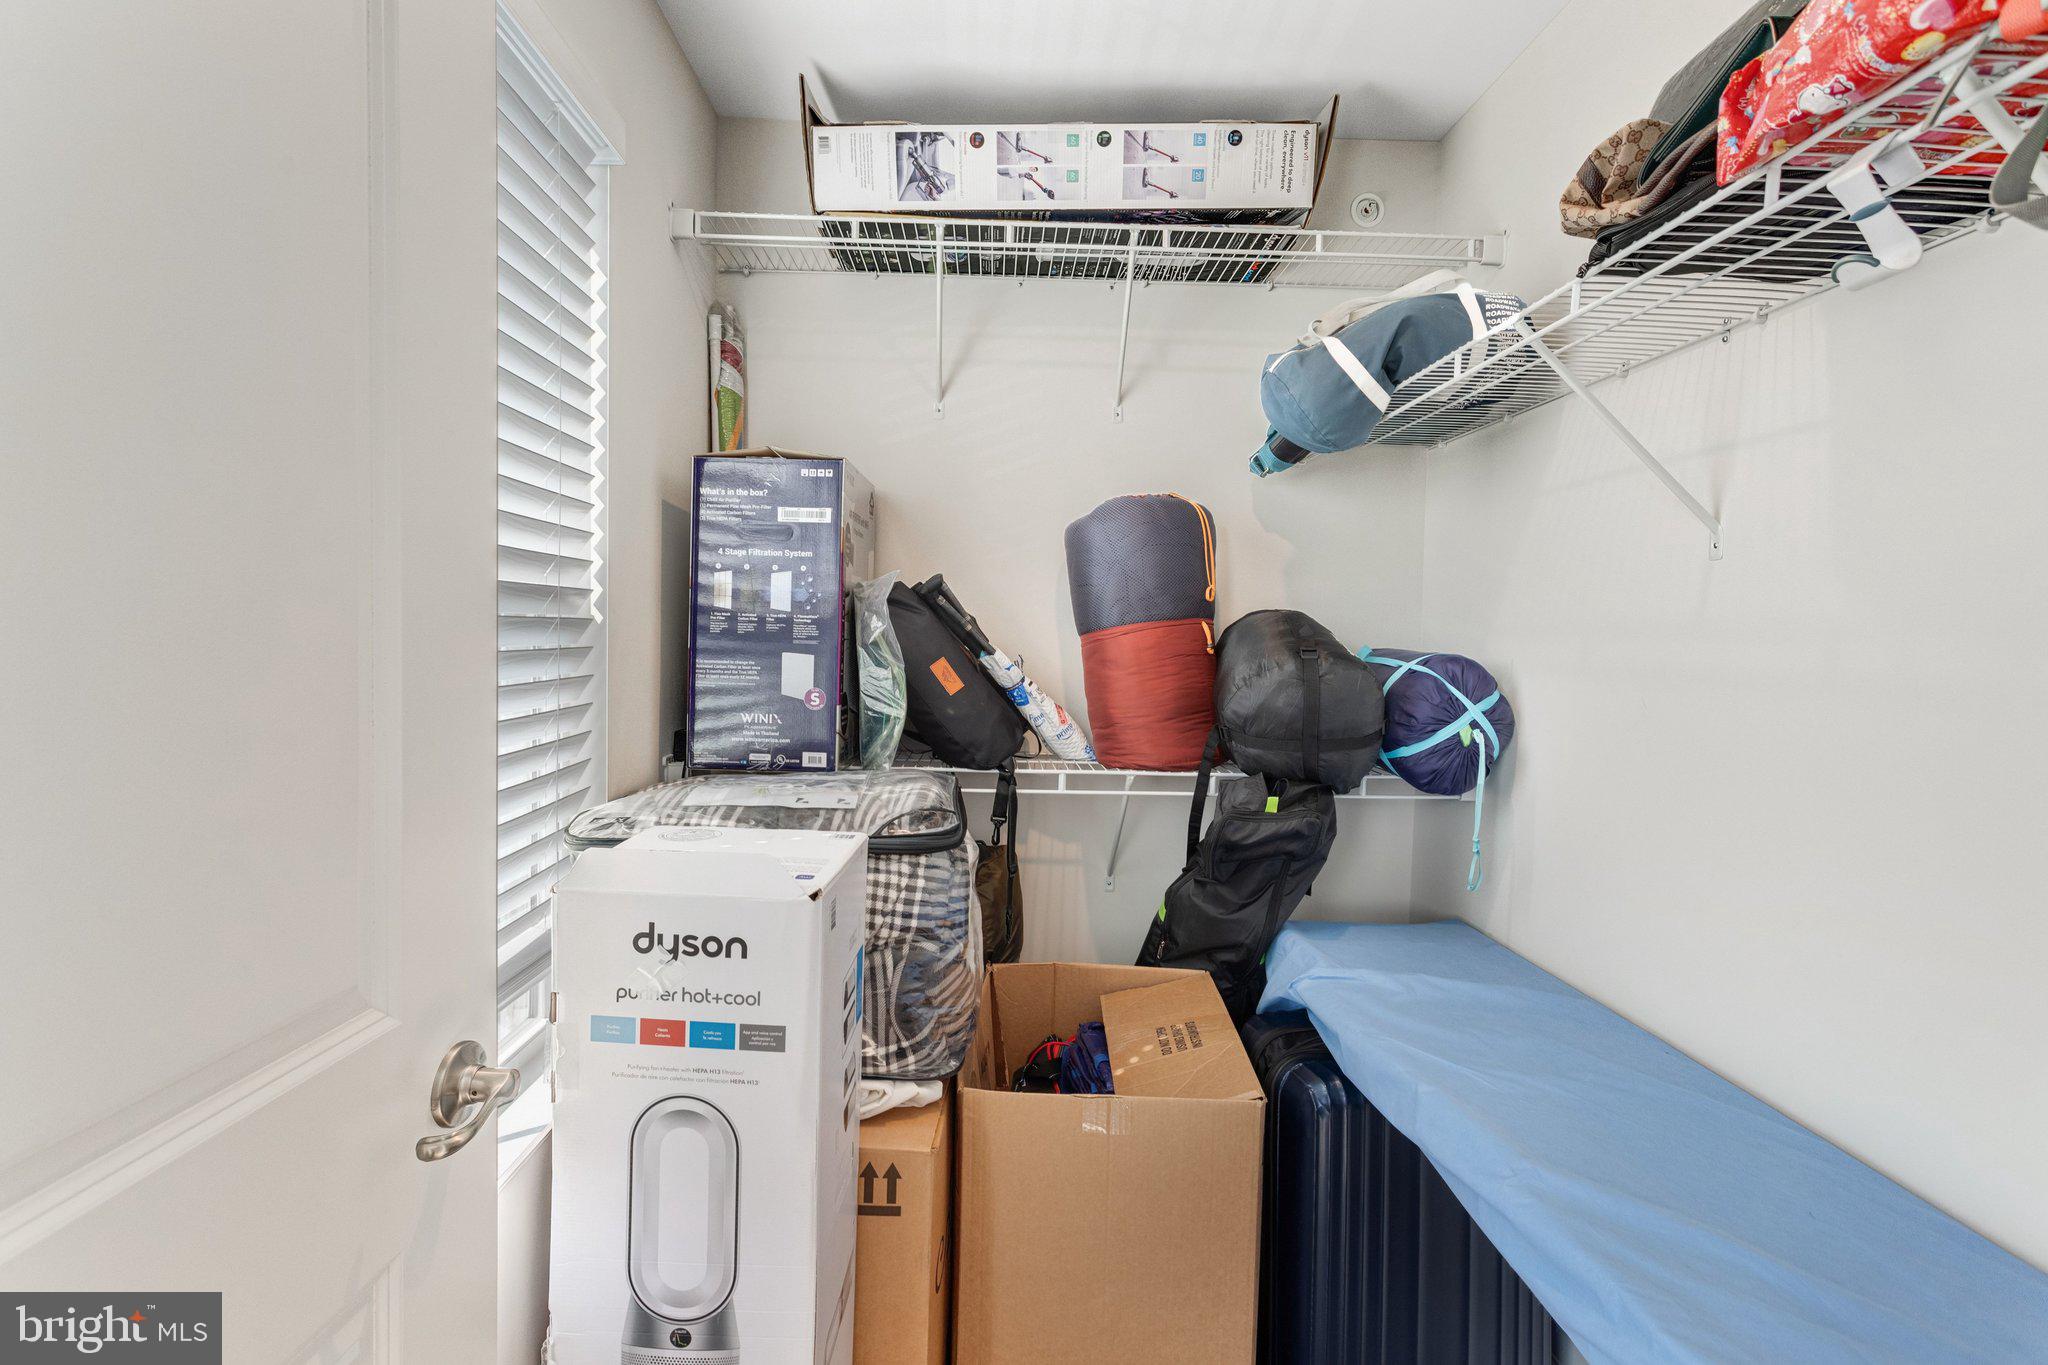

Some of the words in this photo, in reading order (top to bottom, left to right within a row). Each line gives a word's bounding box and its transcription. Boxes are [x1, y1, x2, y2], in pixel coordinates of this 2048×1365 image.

[700, 487, 726, 496] What's
[727, 488, 735, 496] in
[750, 488, 768, 497] box?
[724, 548, 747, 558] Stage
[748, 548, 783, 557] Filtration
[784, 550, 813, 559] System
[810, 692, 820, 706] S
[740, 713, 782, 724] WINIX
[632, 922, 748, 964] dyson
[682, 987, 761, 1006] hot+cool
